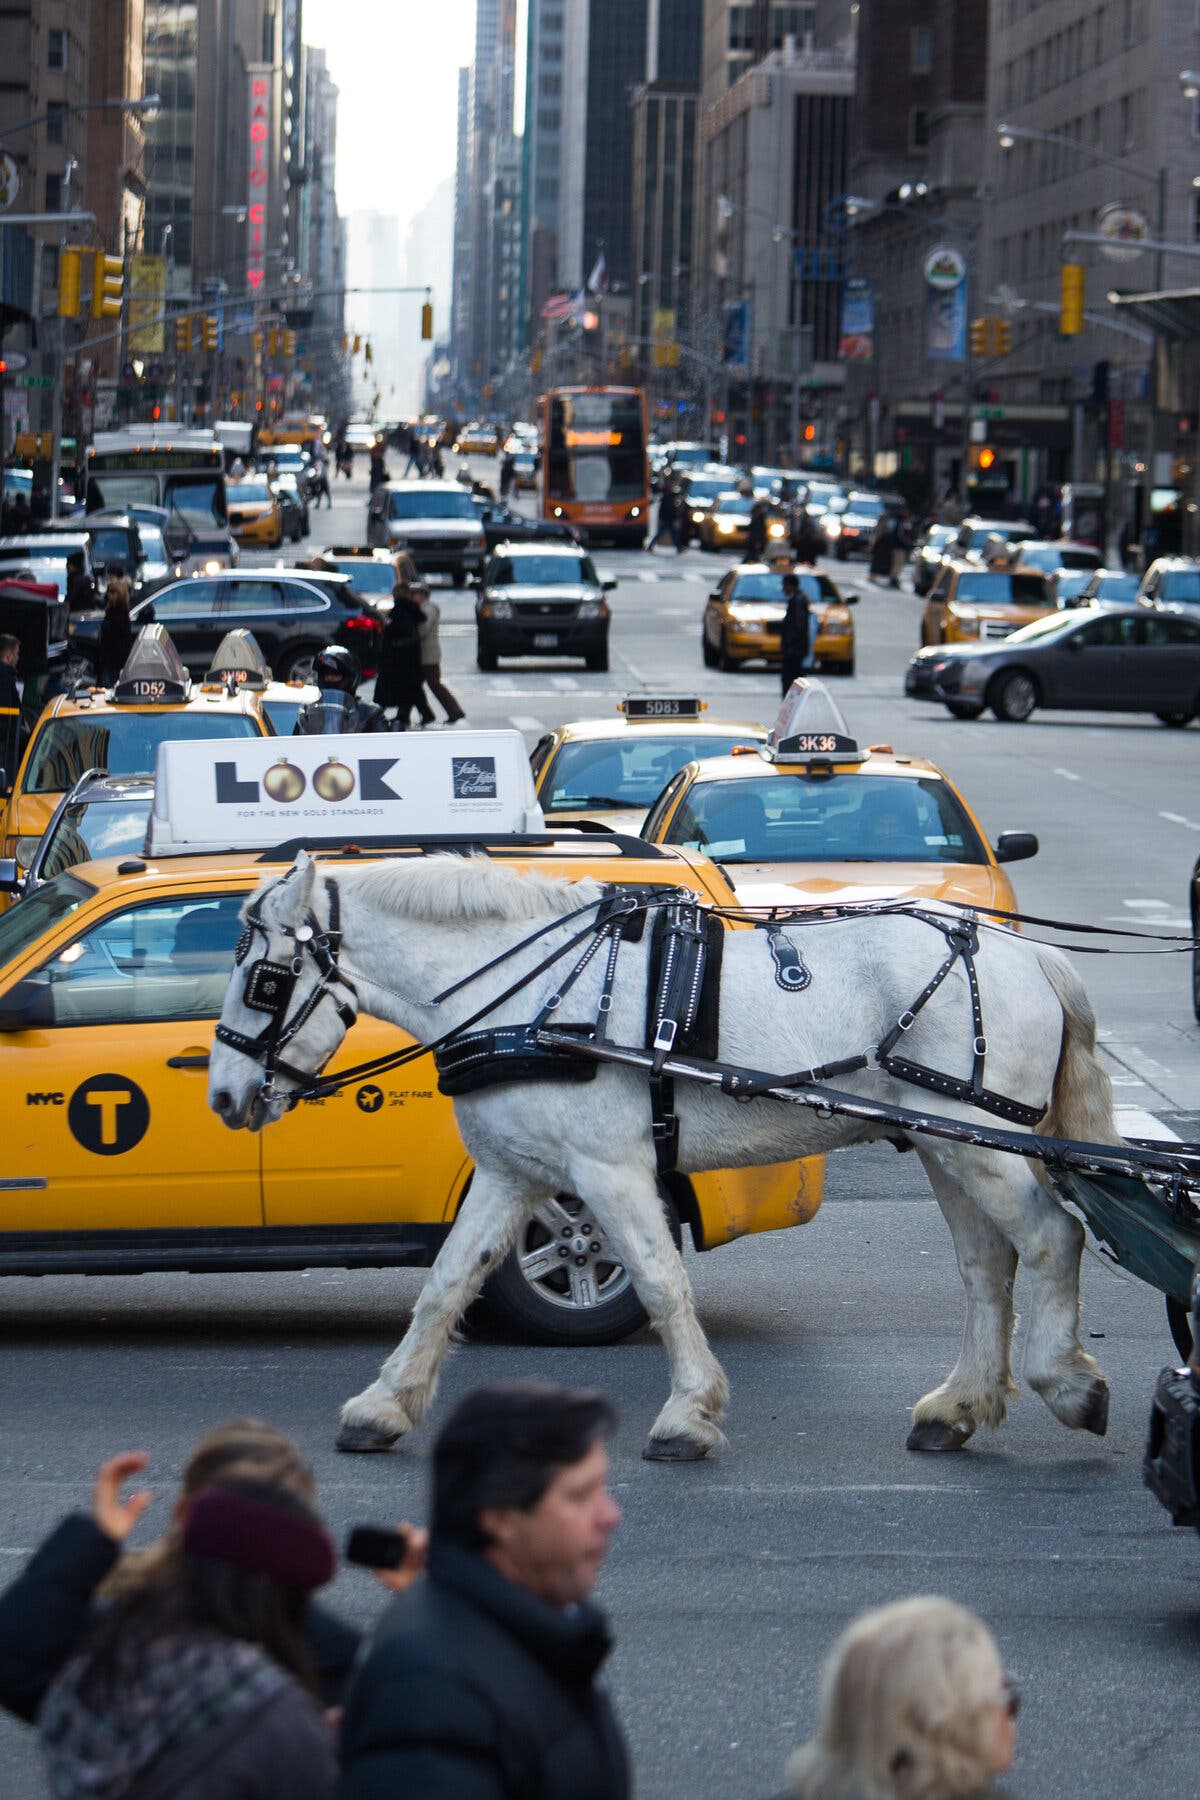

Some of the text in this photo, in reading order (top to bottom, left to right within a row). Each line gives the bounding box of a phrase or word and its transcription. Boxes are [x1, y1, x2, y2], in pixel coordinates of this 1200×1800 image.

[247, 80, 267, 288] RADIO CITY
[133, 681, 165, 695] 1D52
[646, 701, 680, 714] 5D83
[798, 735, 836, 752] 3K36
[215, 757, 403, 803] LOOK
[237, 810, 256, 818] FOR
[279, 809, 299, 817] NEW
[330, 808, 385, 816] STANDARDS
[782, 966, 804, 984] C
[26, 1090, 131, 1145] NYC T
